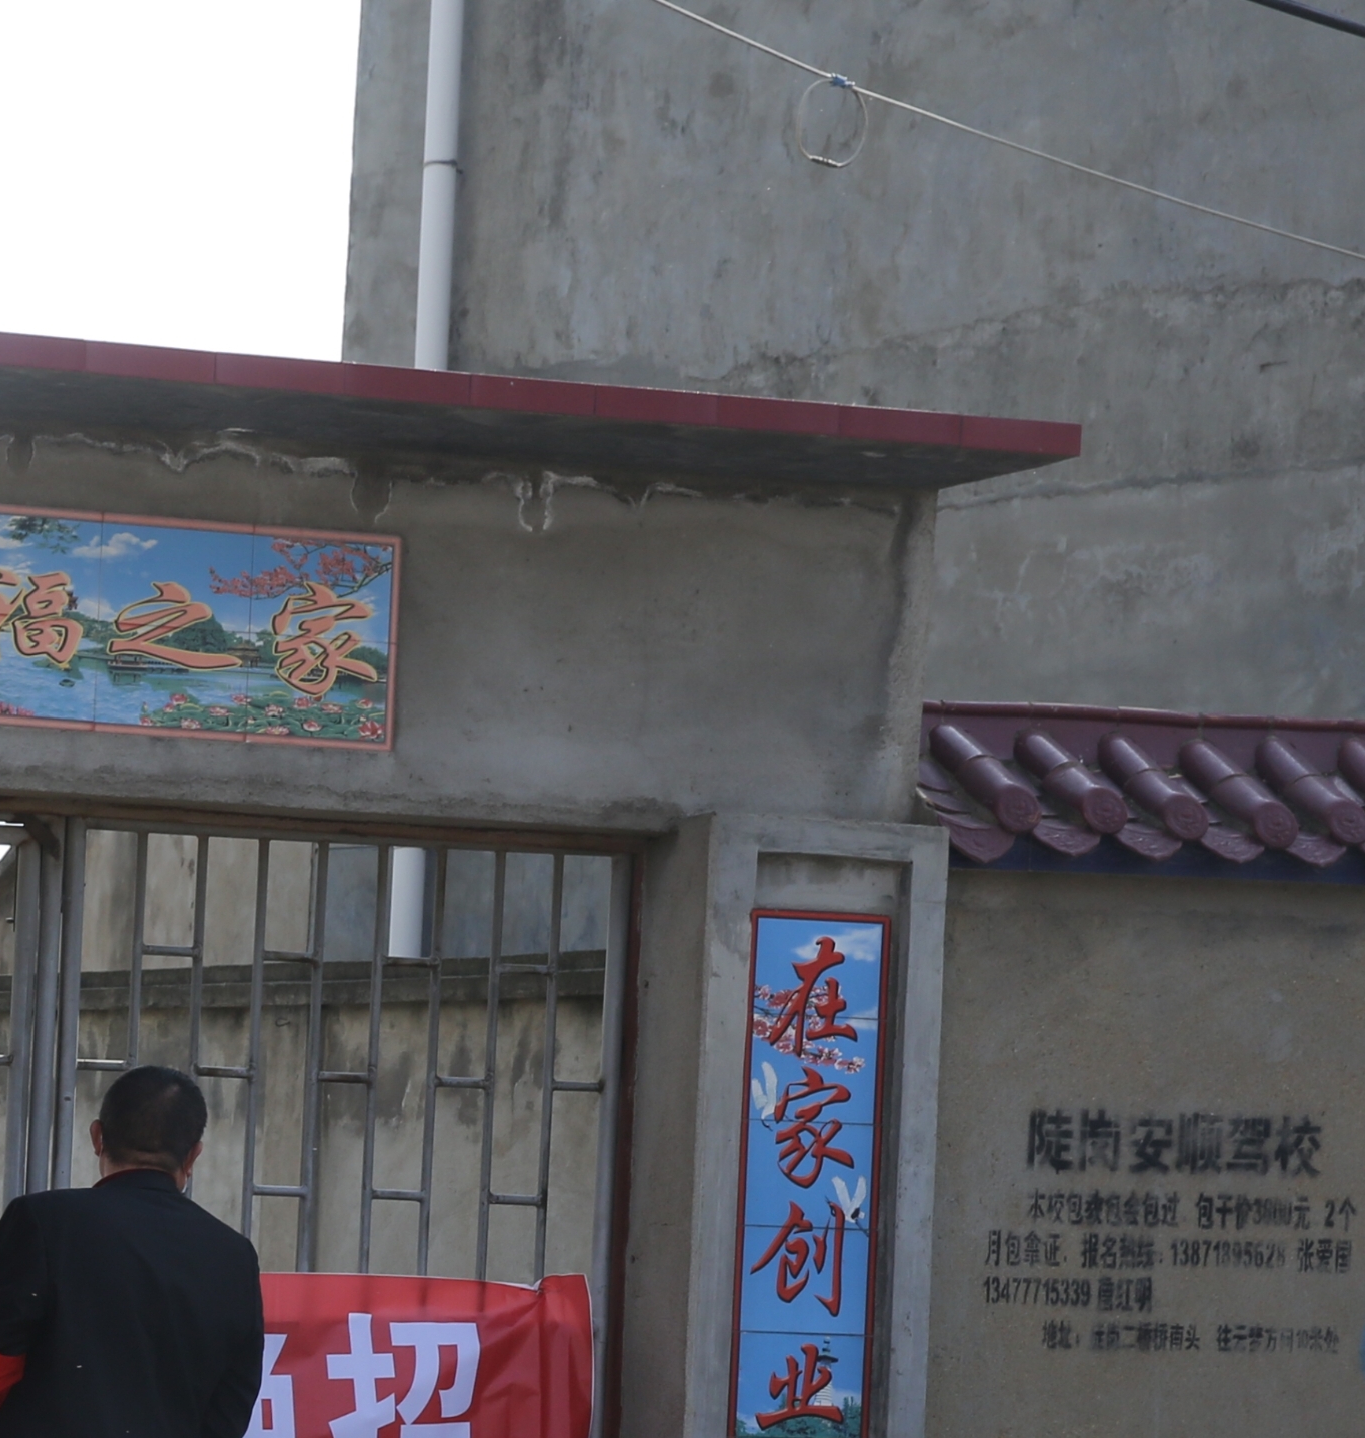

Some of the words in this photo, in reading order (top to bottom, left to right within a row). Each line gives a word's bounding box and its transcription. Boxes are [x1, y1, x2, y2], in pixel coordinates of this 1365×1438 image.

[1027, 1109, 1322, 1177] 陡岗安顺驾校
[983, 1276, 1092, 1307] 13477715339
